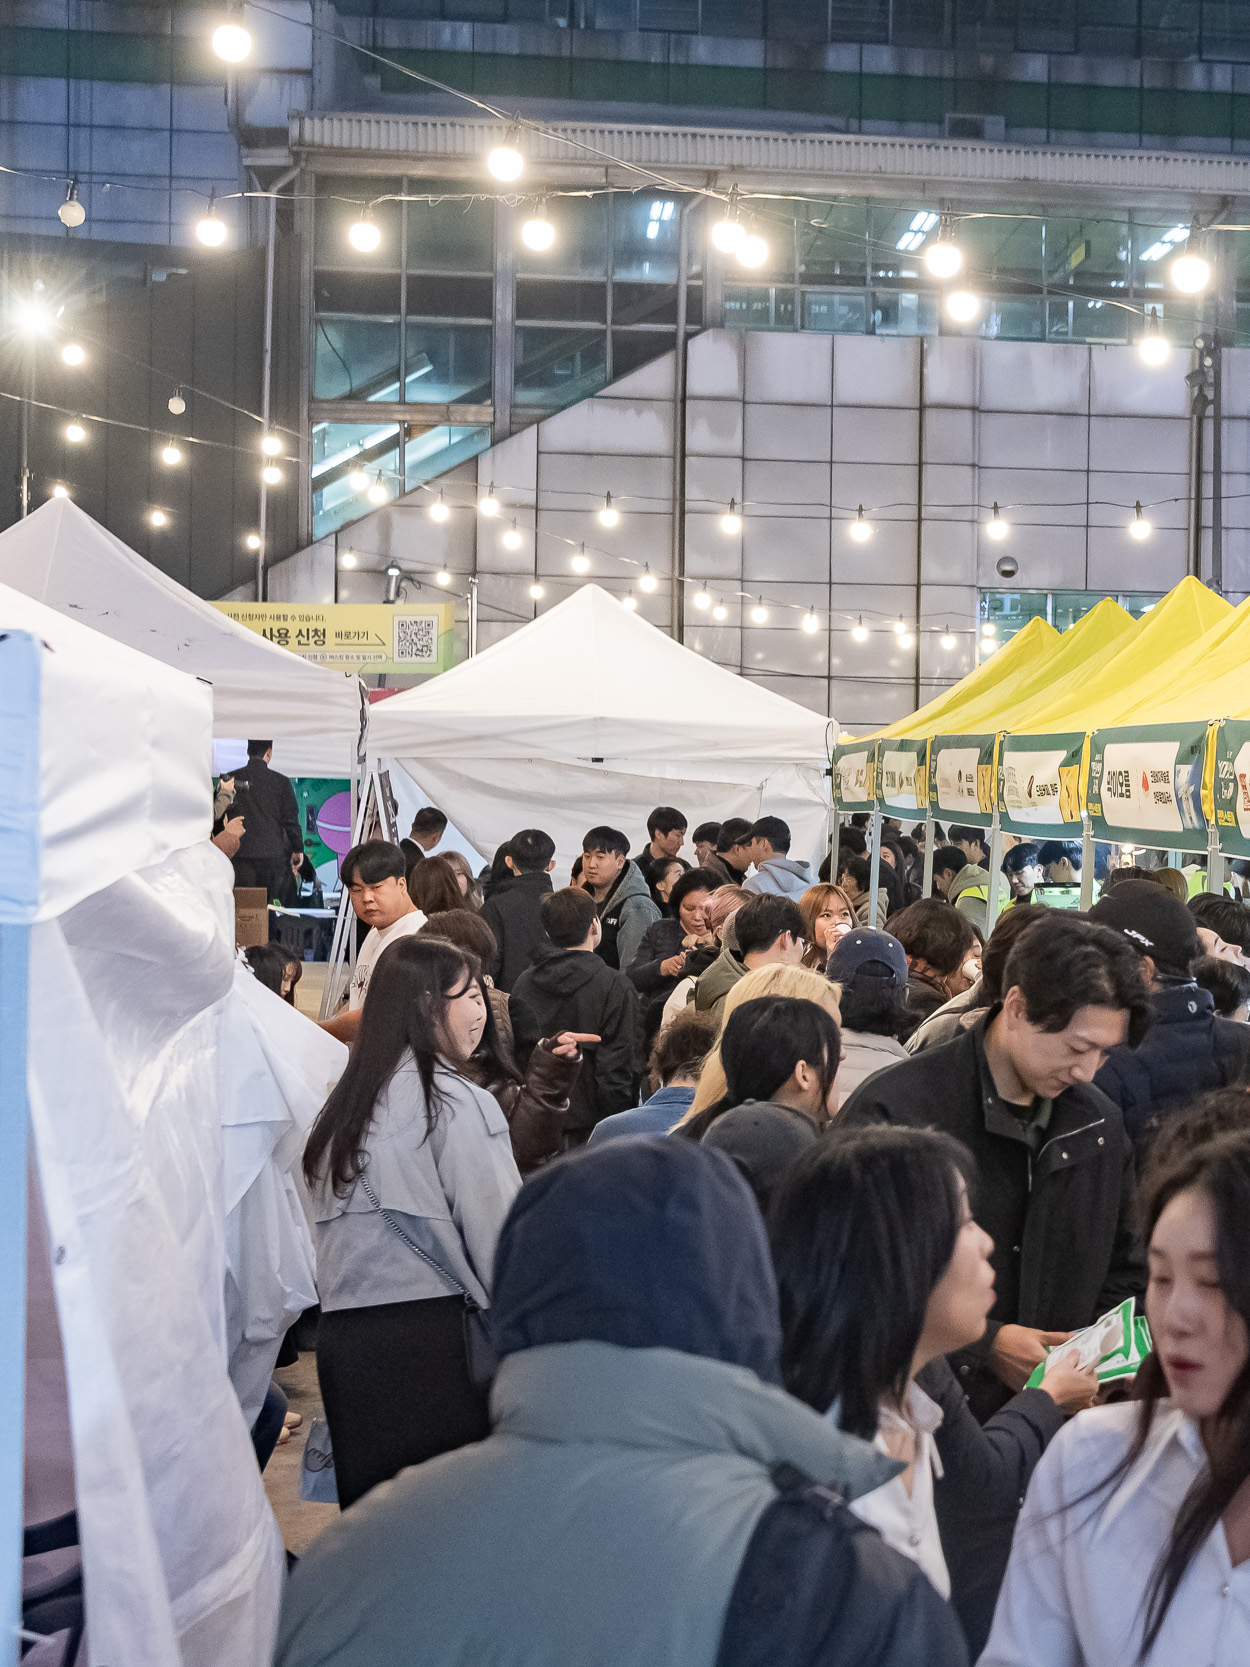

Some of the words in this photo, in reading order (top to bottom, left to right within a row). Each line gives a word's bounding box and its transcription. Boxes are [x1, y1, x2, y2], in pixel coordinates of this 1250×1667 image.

[290, 614, 296, 622] 수
[262, 628, 291, 646] 사용
[296, 628, 326, 646] 신청
[335, 630, 369, 641] 바로가기
